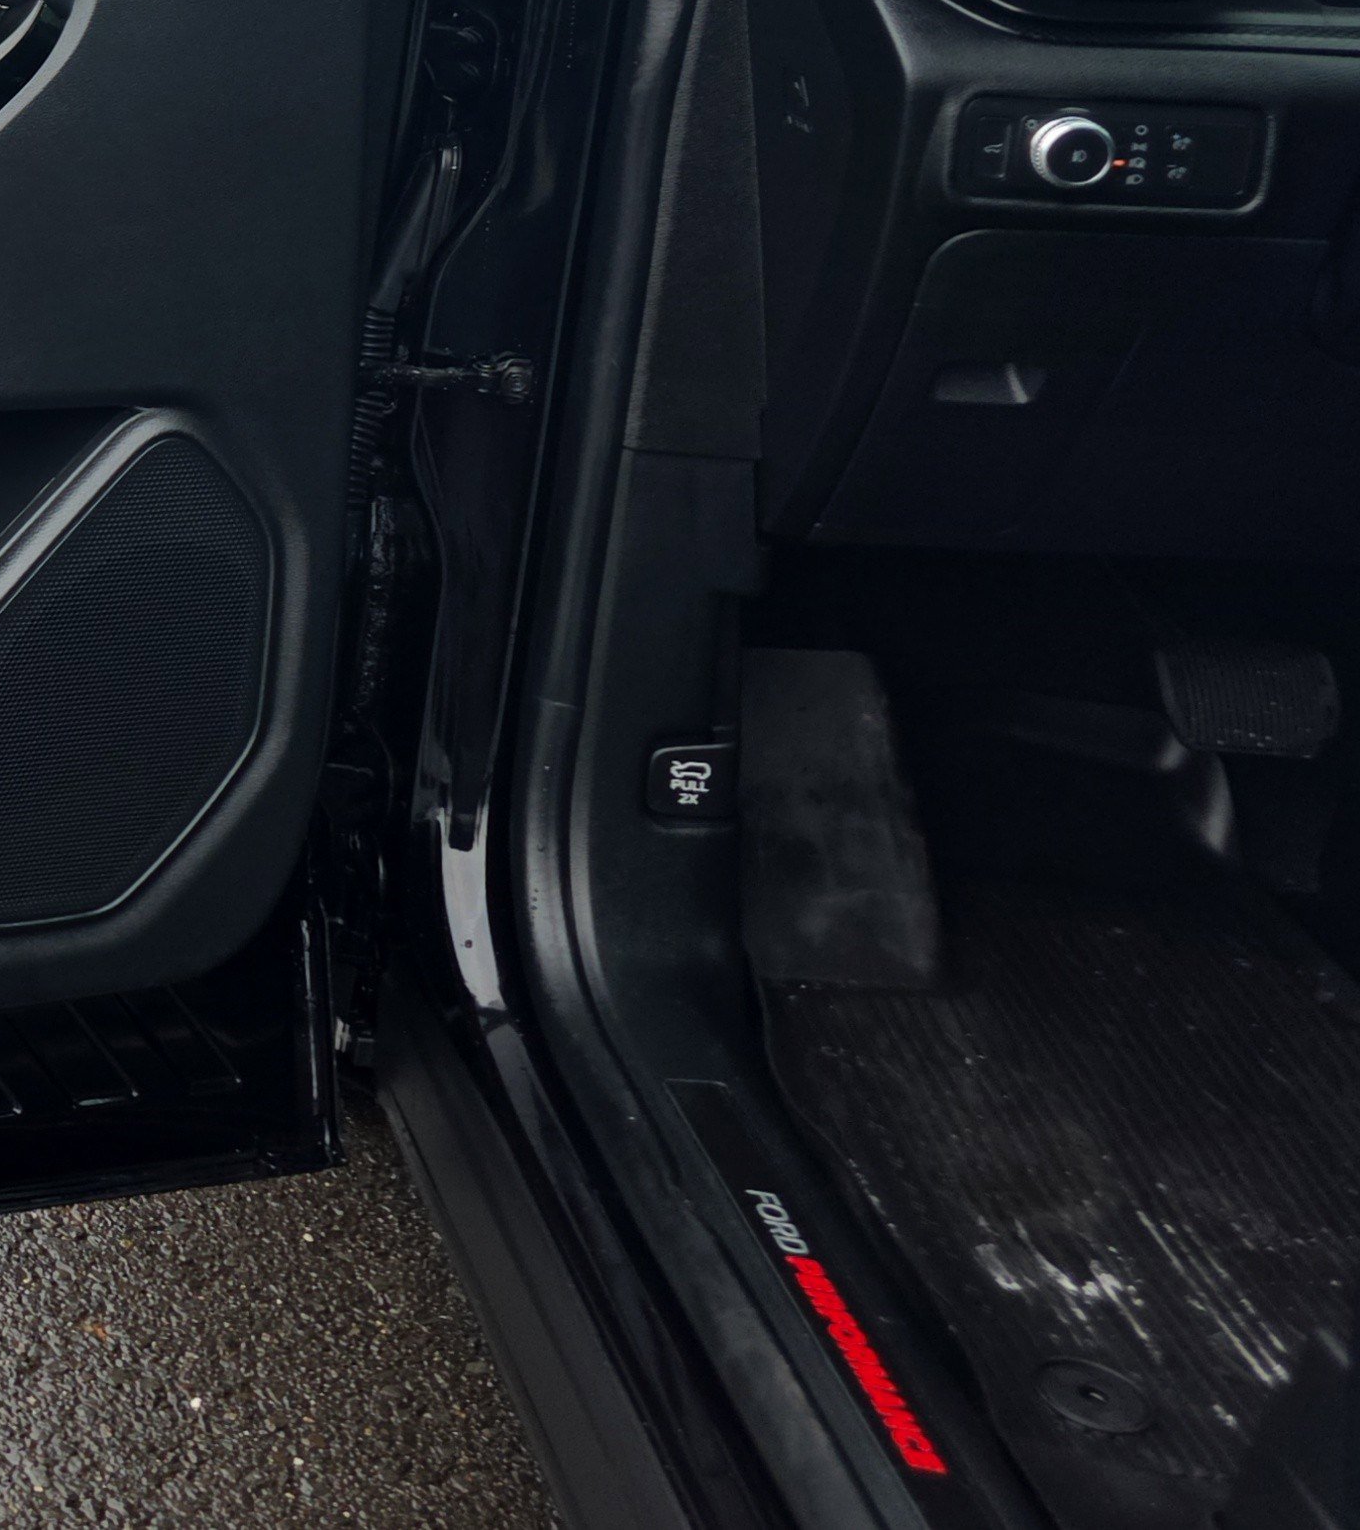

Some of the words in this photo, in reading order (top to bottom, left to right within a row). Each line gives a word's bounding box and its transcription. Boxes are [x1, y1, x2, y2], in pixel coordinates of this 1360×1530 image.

[669, 779, 710, 792] PULL
[677, 793, 699, 805] 2X
[745, 1189, 810, 1255] FORD
